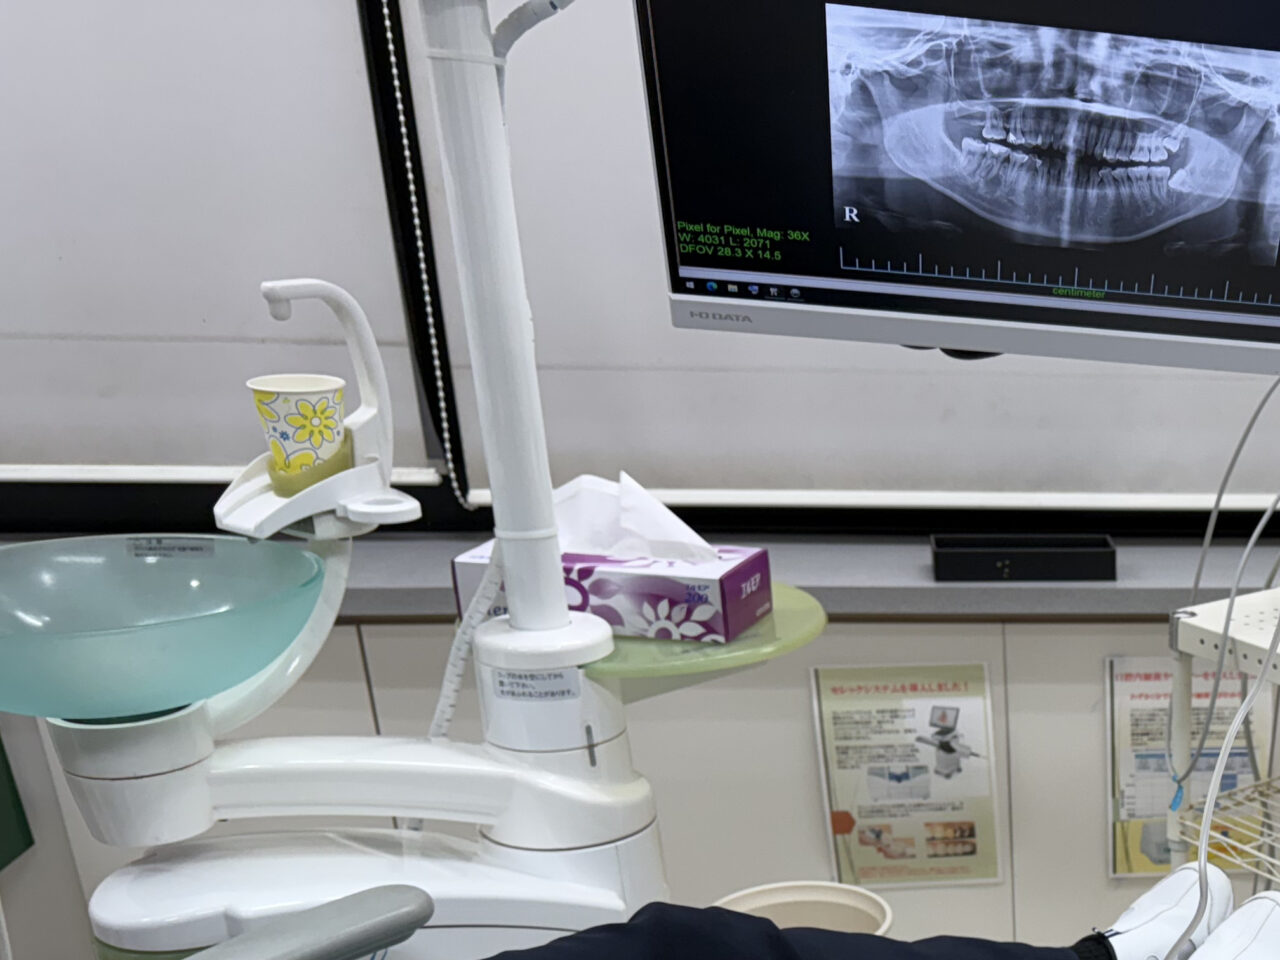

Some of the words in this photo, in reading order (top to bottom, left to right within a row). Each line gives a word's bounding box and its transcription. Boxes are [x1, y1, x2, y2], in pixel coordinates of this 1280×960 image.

[843, 206, 860, 223] R
[677, 221, 704, 233] Pixel
[706, 223, 721, 234] for
[787, 230, 810, 241] 36X
[698, 234, 725, 245] 4031
[743, 238, 771, 249] 2071
[680, 244, 714, 255] DFOV
[717, 247, 742, 257] 28.3
[1052, 287, 1106, 299] centimeter
[712, 312, 753, 323] DATA
